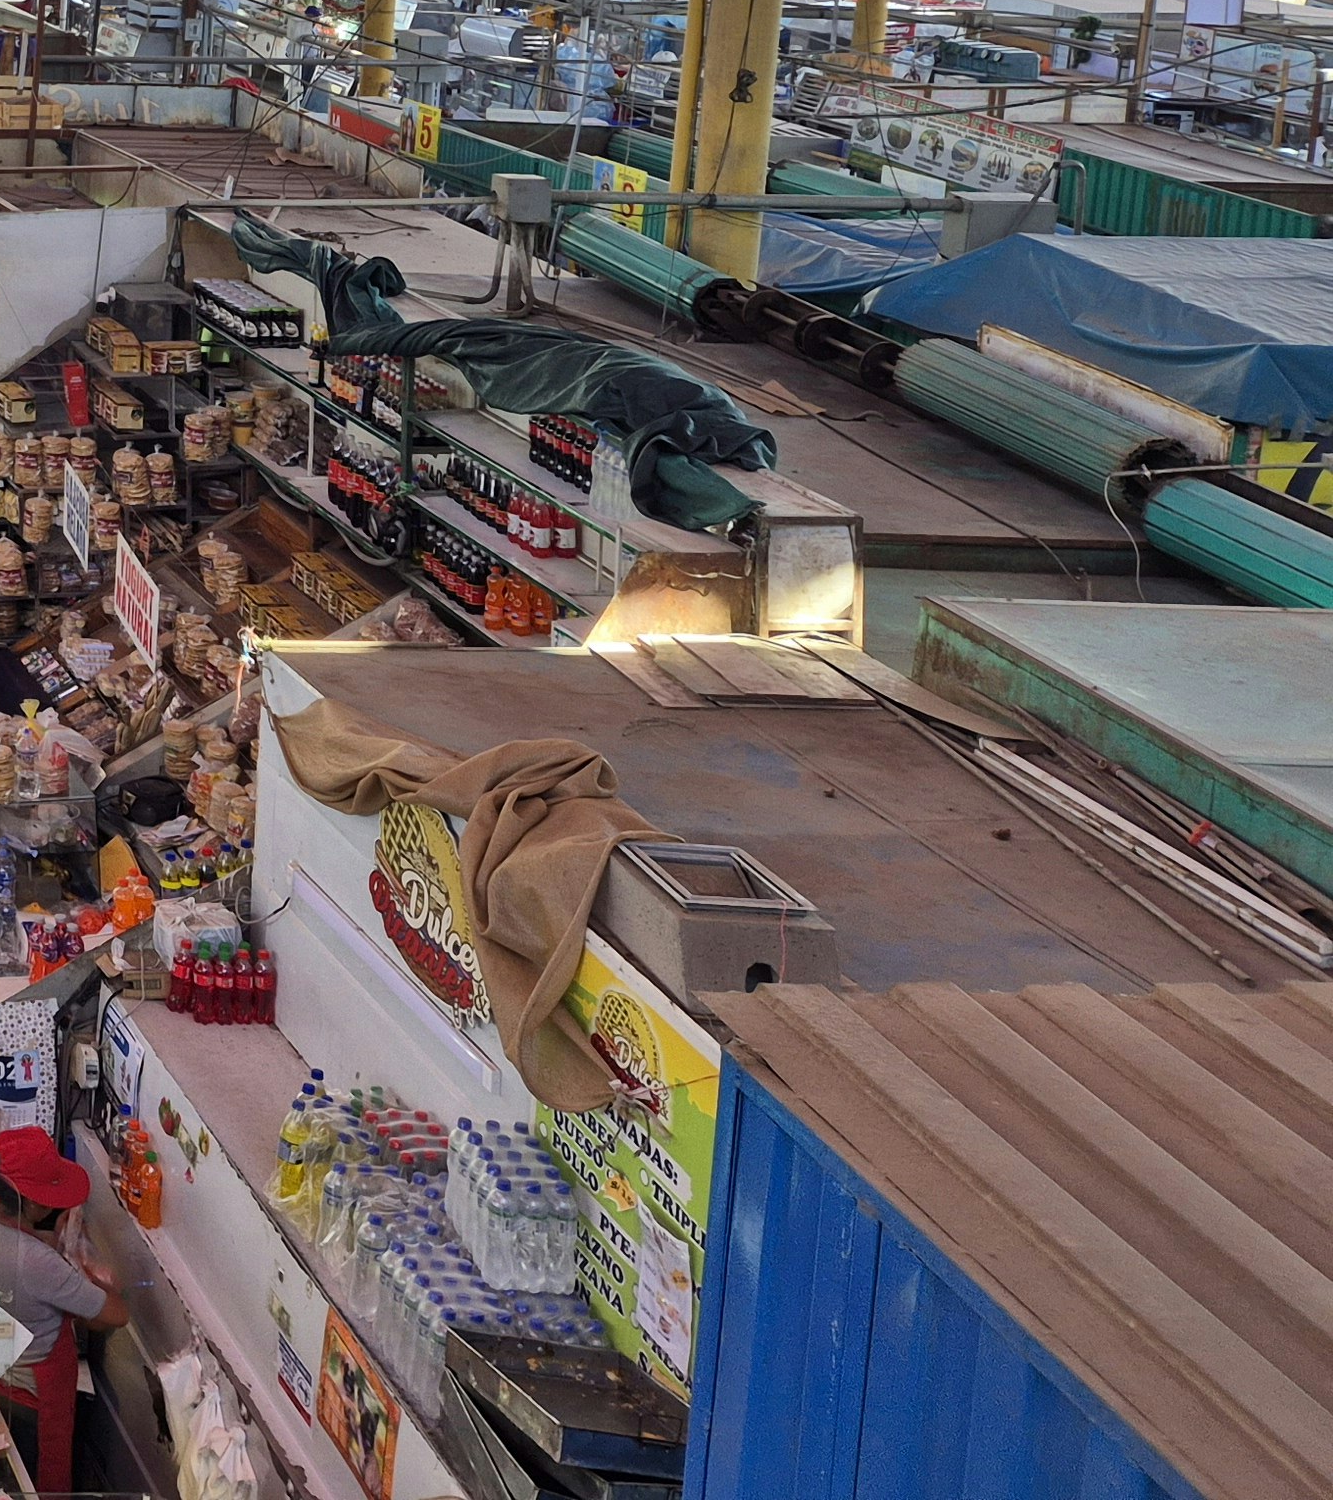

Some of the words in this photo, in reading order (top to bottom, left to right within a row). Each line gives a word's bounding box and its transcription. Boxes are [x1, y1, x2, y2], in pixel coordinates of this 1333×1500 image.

[420, 116, 433, 149] 5
[119, 546, 154, 620] YOGURT
[115, 577, 154, 661] NATURAL
[551, 1129, 599, 1192] POLLO
[553, 1108, 604, 1168] QUESO
[599, 1211, 637, 1264] PYE:
